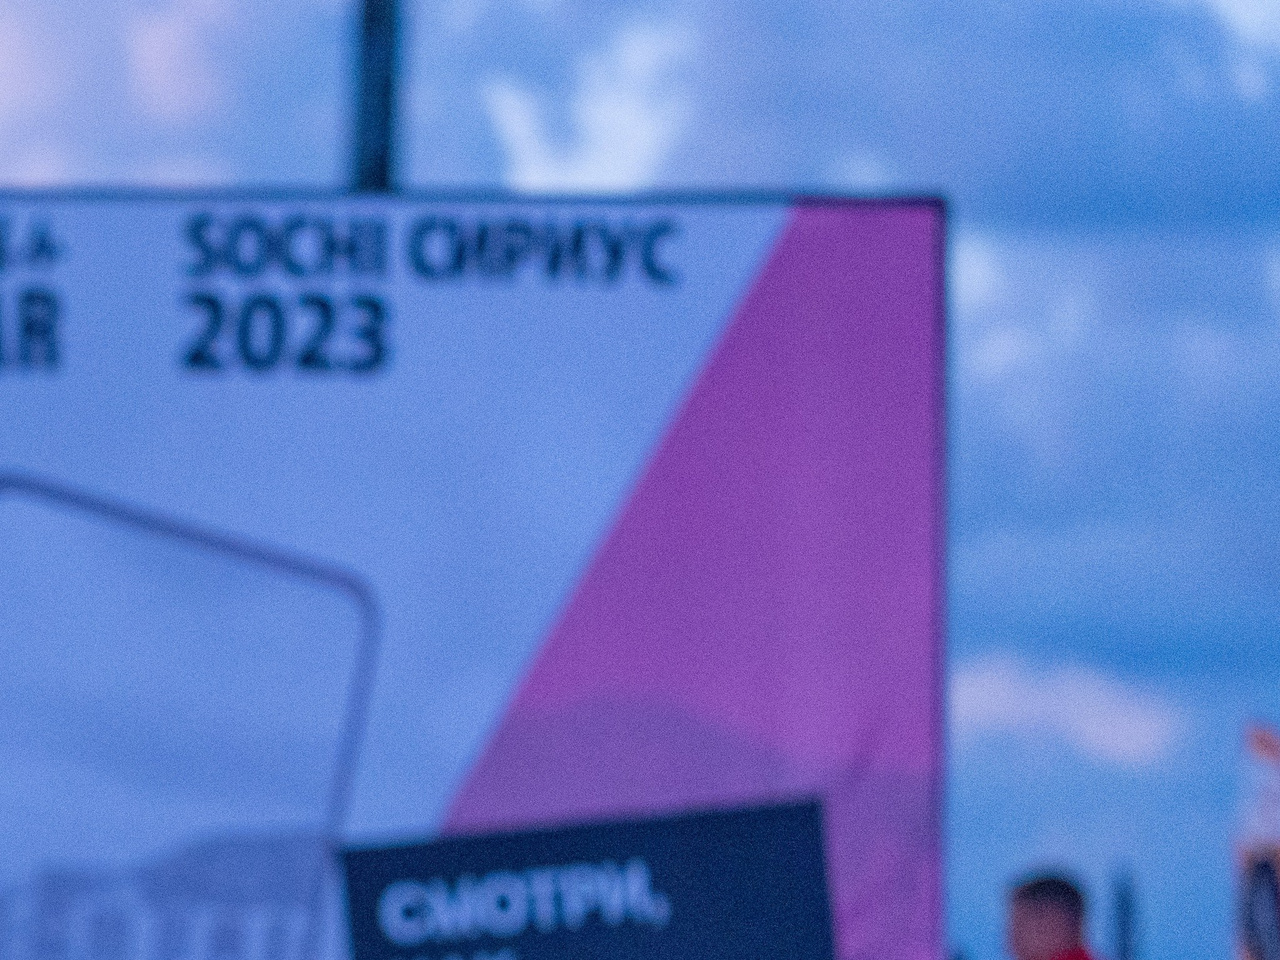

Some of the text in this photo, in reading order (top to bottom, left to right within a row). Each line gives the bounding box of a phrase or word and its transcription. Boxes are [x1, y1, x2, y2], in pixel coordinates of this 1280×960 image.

[183, 213, 678, 287] SOCHI СИРИУС
[183, 293, 389, 373] 2023
